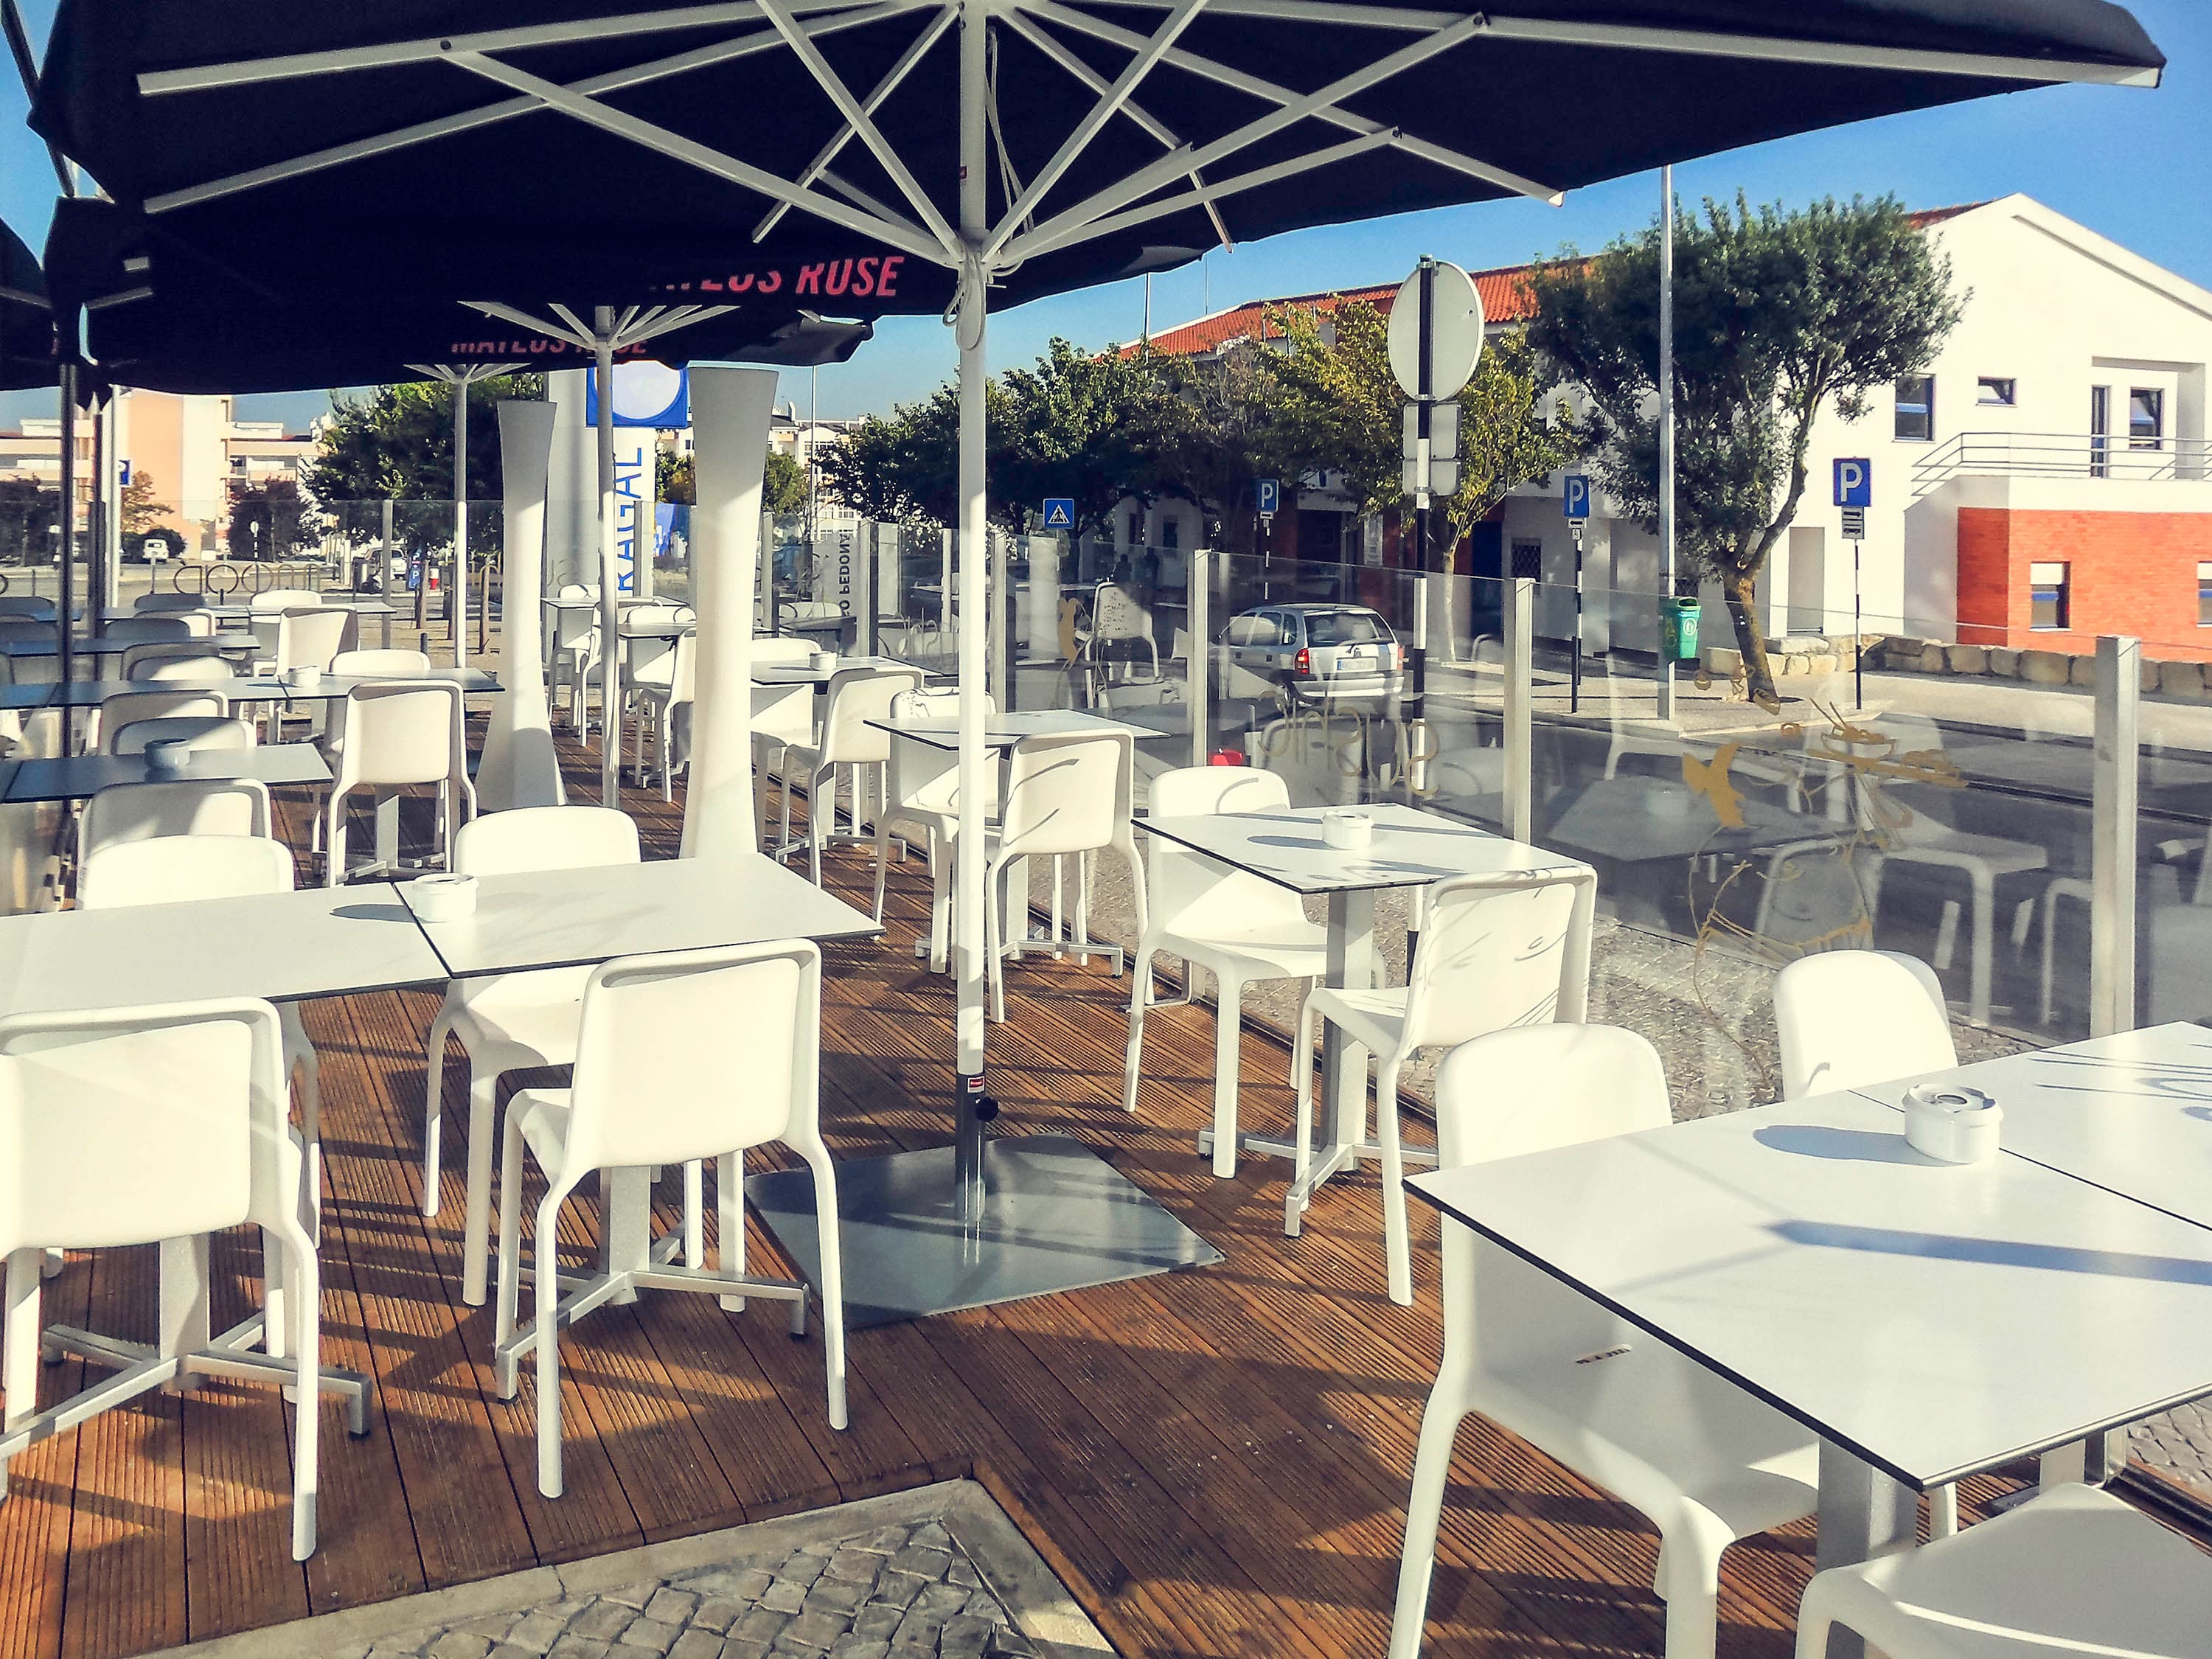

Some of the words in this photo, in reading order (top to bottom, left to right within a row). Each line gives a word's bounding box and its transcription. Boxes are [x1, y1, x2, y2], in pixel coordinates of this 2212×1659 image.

[1262, 483, 1273, 508] P
[1569, 479, 1584, 514] P
[1840, 462, 1863, 502] P
